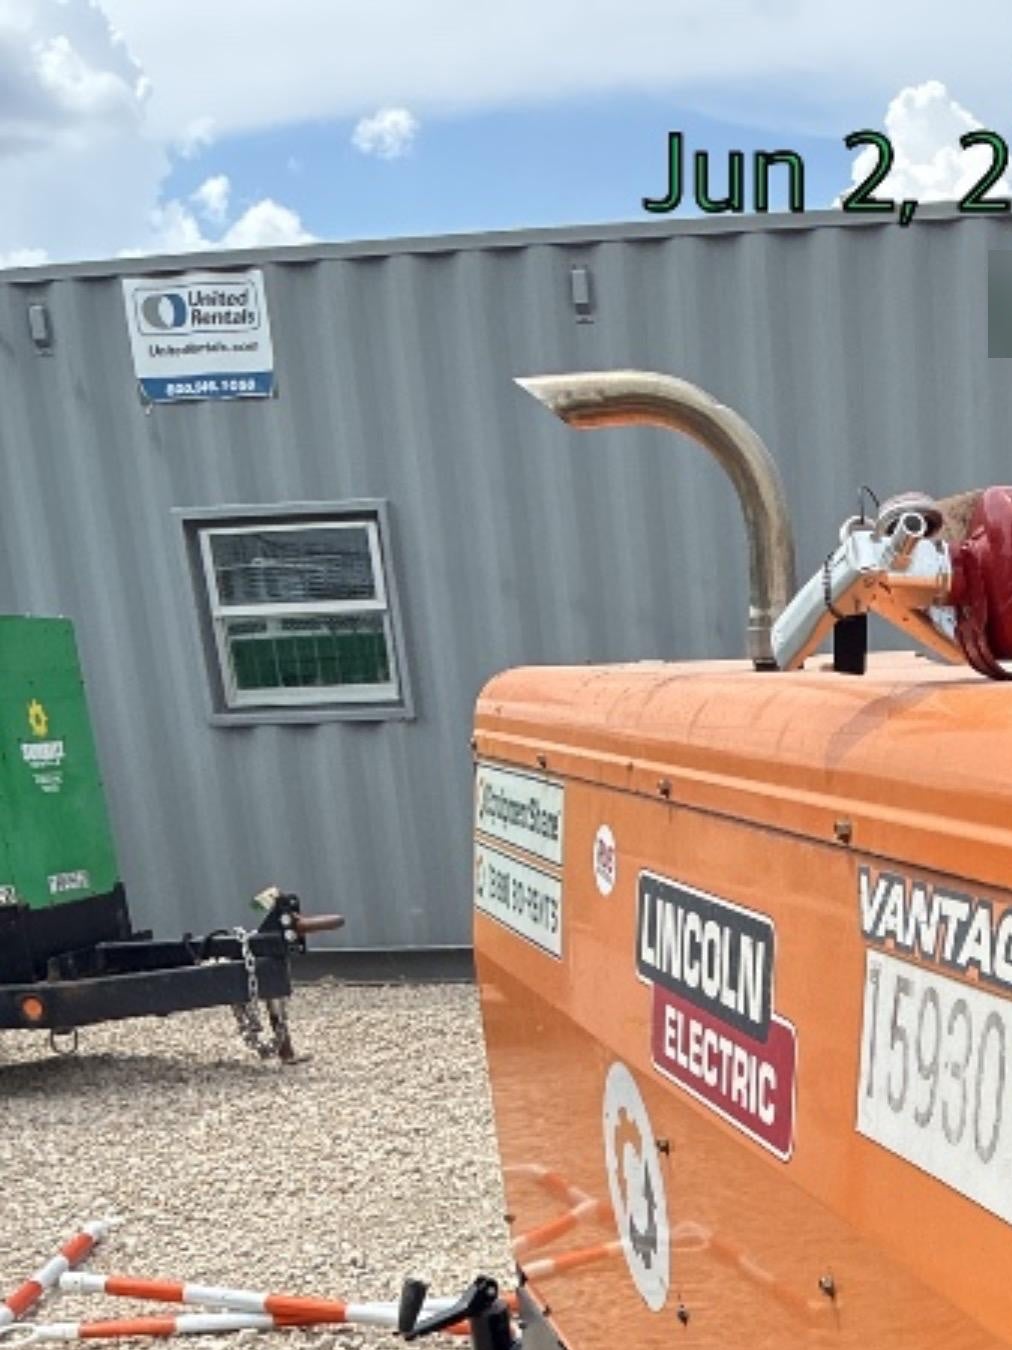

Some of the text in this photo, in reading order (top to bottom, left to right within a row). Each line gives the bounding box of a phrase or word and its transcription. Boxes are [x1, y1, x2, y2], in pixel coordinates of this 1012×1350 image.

[188, 290, 249, 306] United
[191, 309, 256, 327] Rentals
[641, 892, 766, 1024] LINCOLN
[664, 1004, 777, 1127] ELECTRIC
